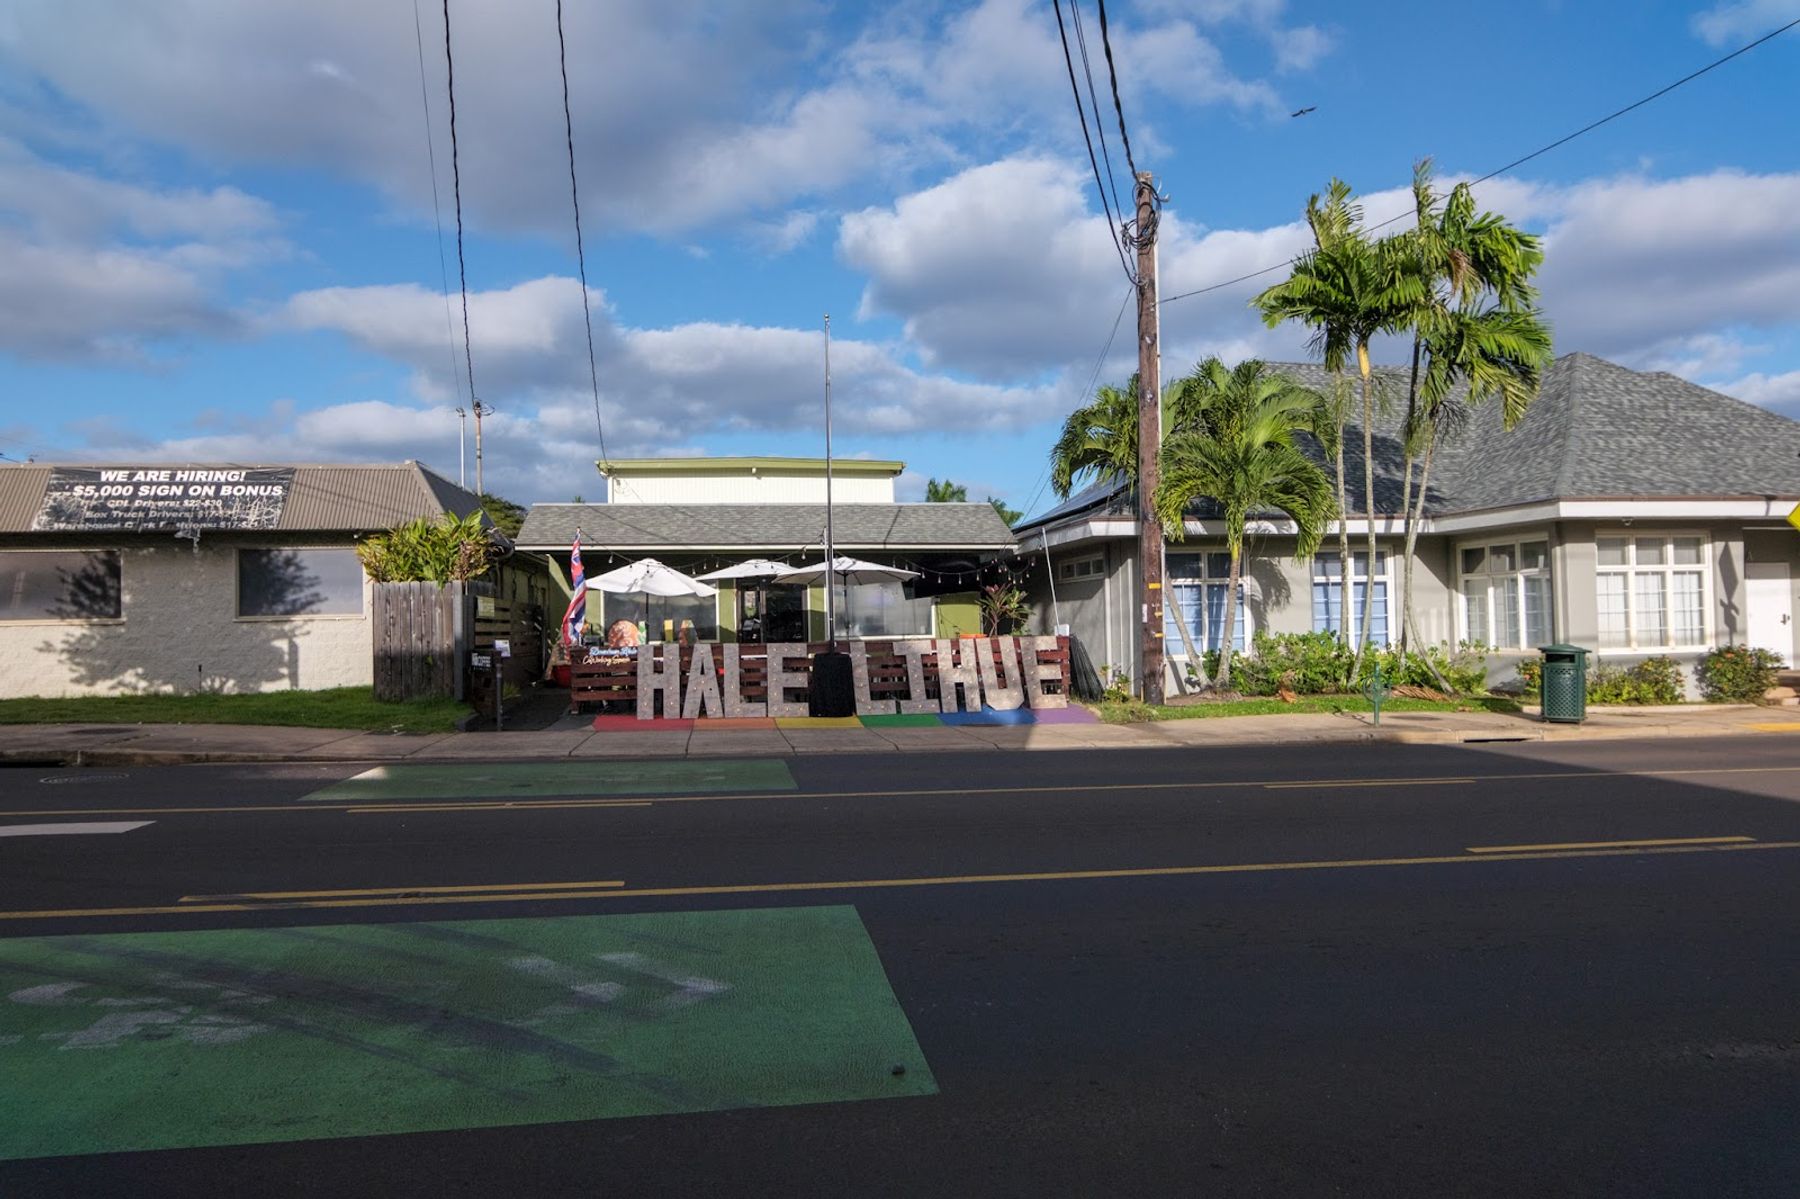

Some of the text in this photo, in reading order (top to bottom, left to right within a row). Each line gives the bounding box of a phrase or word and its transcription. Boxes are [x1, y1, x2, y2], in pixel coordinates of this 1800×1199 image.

[101, 470, 246, 482] WE ARE HIRING!
[73, 485, 283, 498] $5,000 SIGN ON BONUS
[111, 510, 145, 518] Truck
[637, 635, 1068, 720] HALE LIHUE
